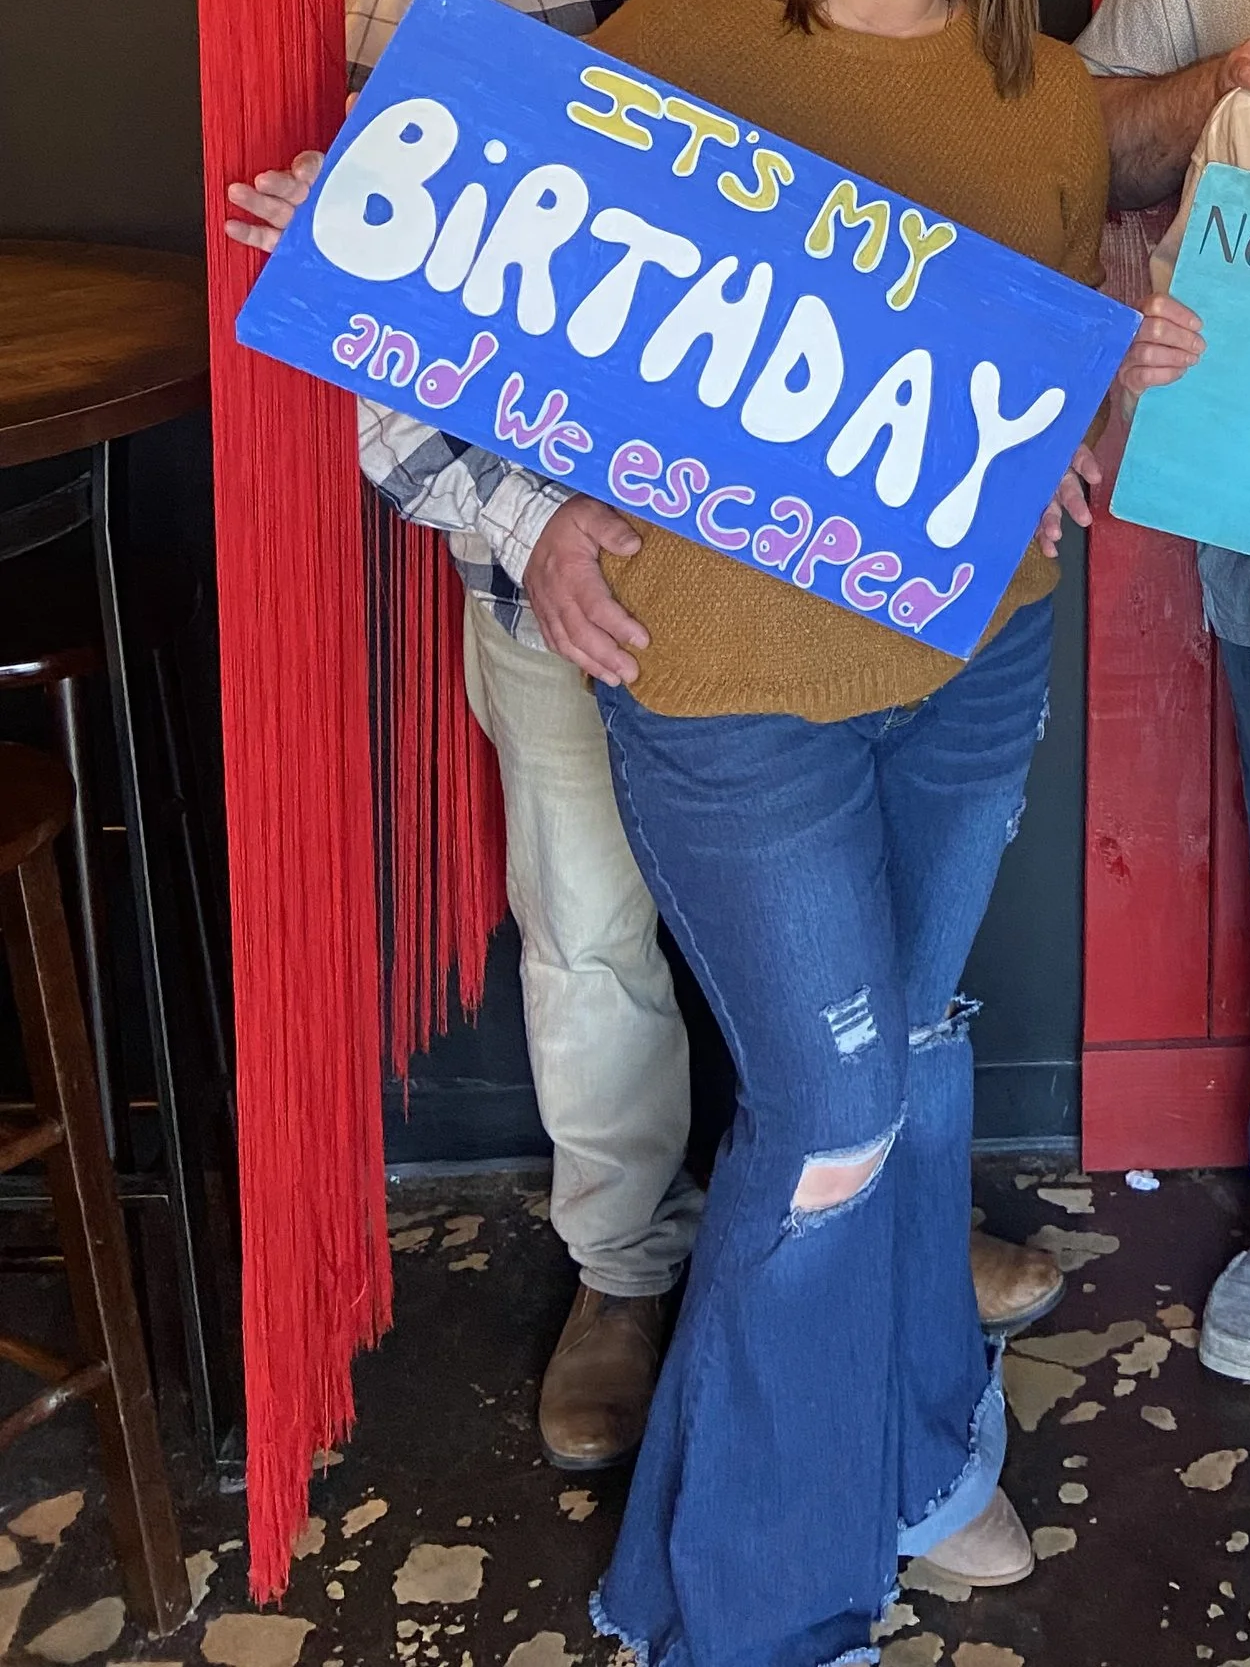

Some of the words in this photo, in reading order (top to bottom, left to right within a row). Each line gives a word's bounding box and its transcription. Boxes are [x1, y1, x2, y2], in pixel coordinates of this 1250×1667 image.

[567, 66, 795, 214] IT'S
[804, 180, 957, 312] MY
[332, 313, 498, 410] and
